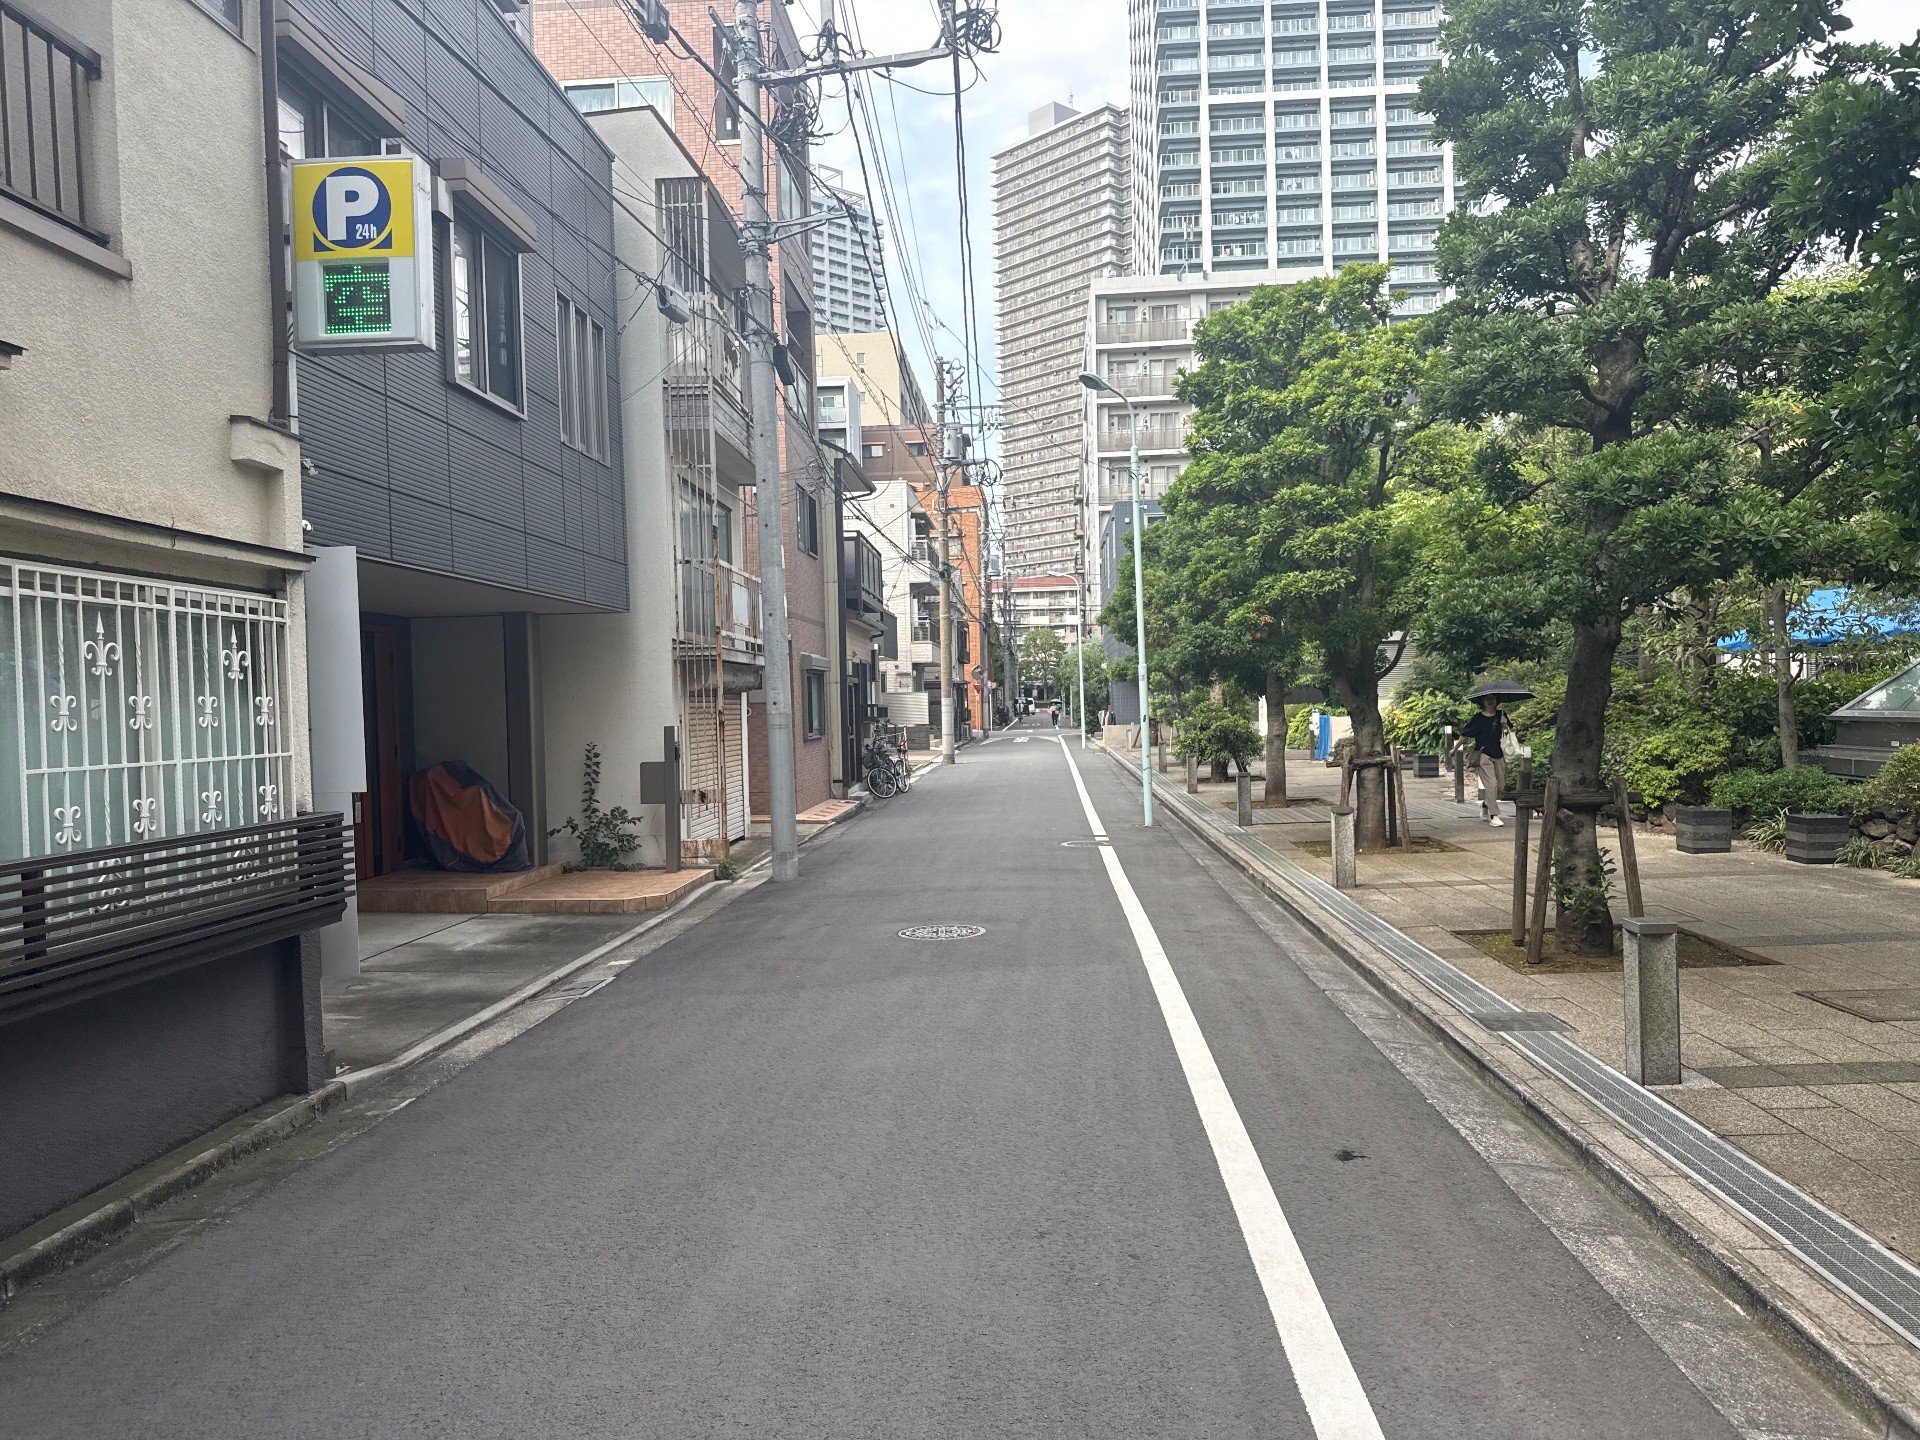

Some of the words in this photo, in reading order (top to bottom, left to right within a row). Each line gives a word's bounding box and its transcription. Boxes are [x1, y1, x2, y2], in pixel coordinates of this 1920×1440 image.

[326, 175, 379, 240] P
[355, 223, 377, 239] 24h
[325, 265, 392, 334] 空
